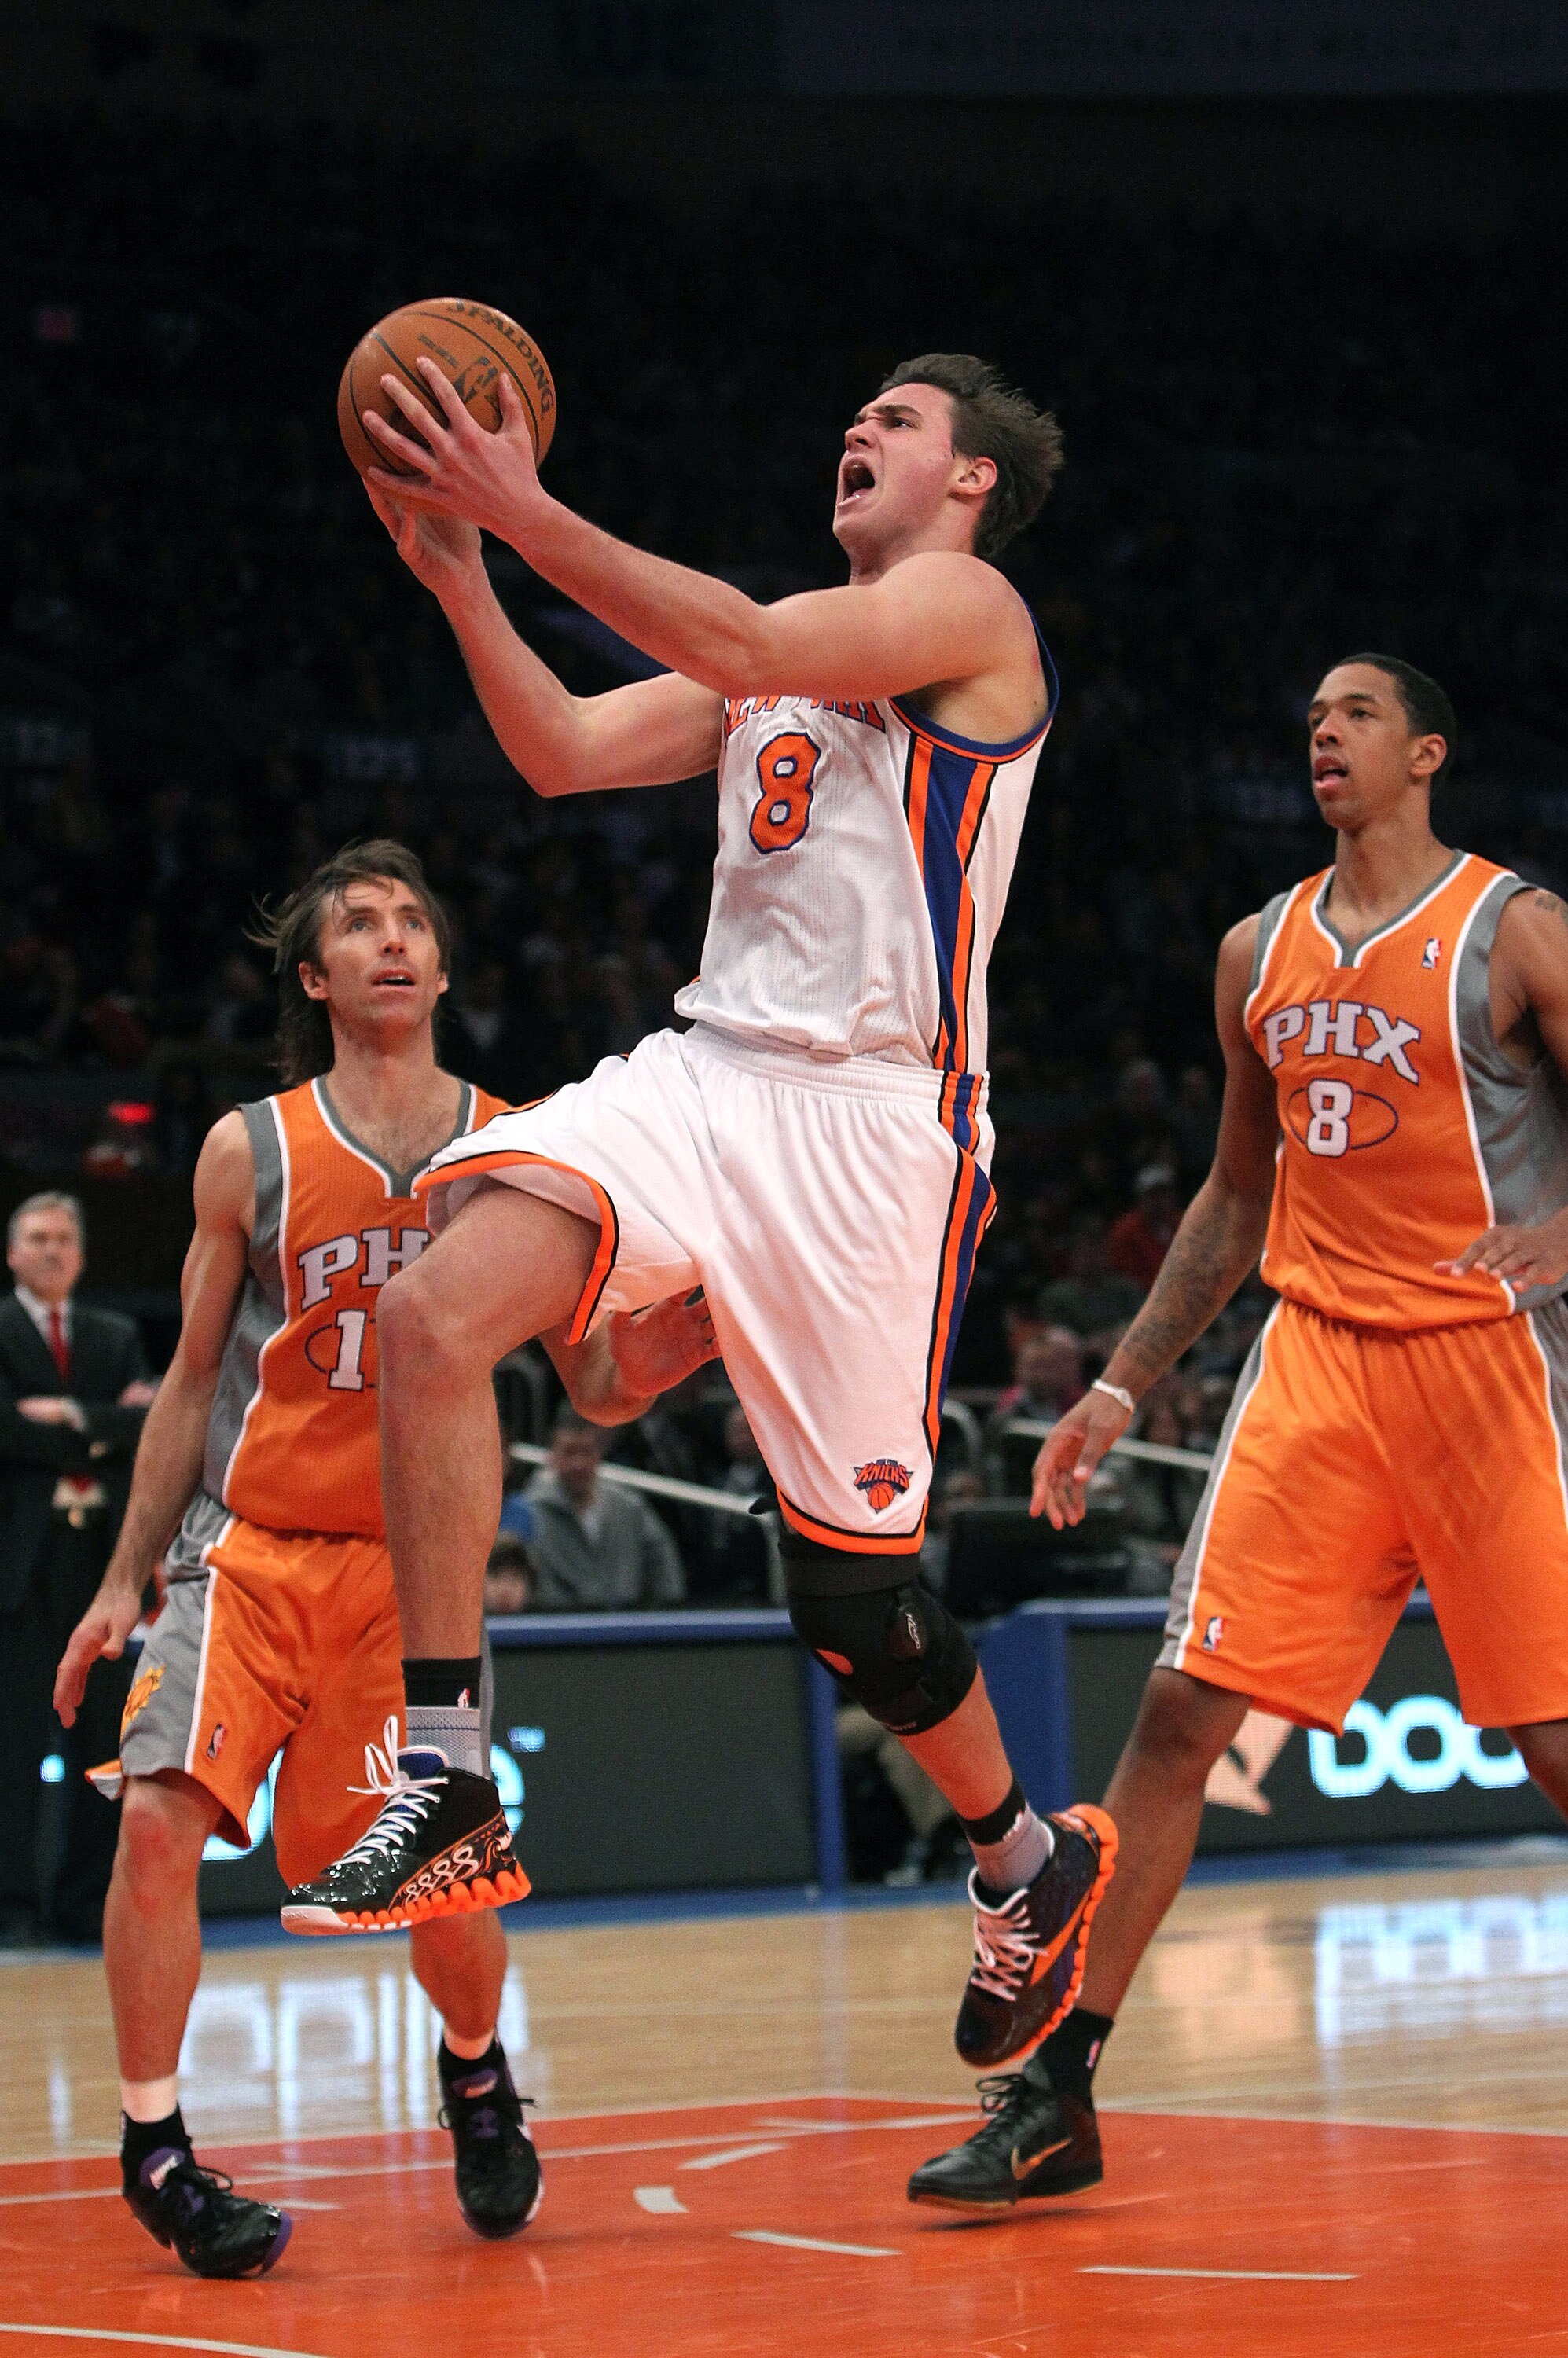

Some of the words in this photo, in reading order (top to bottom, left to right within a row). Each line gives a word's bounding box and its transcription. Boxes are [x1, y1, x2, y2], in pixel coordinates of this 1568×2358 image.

[749, 732, 821, 854] 8
[1262, 1000, 1422, 1087] PHX
[1305, 1078, 1354, 1159] 8
[327, 1308, 369, 1392] 1
